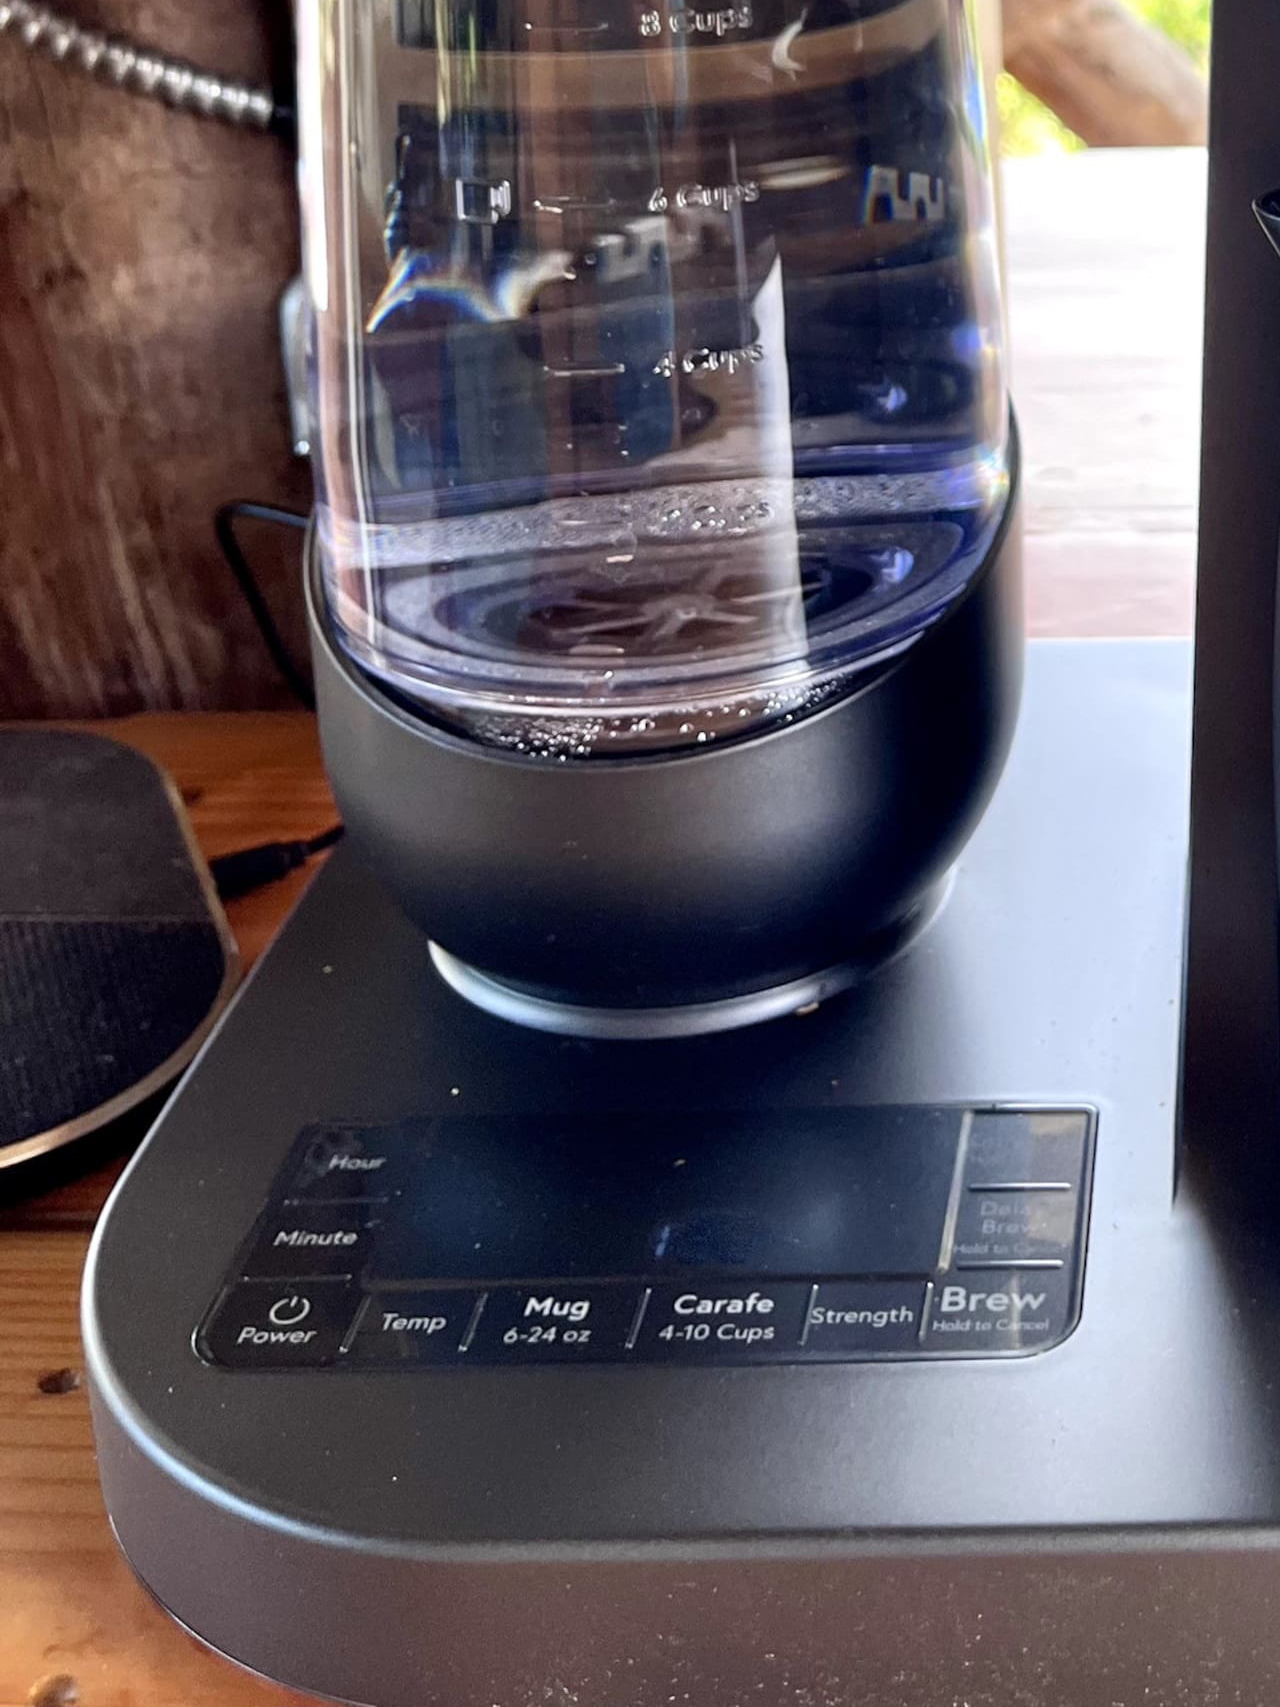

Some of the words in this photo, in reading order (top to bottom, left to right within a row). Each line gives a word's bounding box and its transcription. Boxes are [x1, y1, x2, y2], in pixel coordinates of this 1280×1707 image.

[640, 9, 662, 36] 8
[668, 5, 754, 36] Cups
[647, 186, 668, 212] 6
[676, 181, 760, 212] Cups
[328, 1154, 387, 1172] Hour
[272, 1229, 359, 1247] Minute
[523, 1296, 590, 1322] Mug
[673, 1292, 775, 1314] Carafe
[940, 1285, 1047, 1313] Brew
[381, 1312, 448, 1335] Temp
[810, 1305, 914, 1329] Strength
[932, 1318, 971, 1333] Hold
[975, 1318, 992, 1332] to
[995, 1318, 1050, 1332] Cancel
[236, 1326, 318, 1345] Power
[503, 1325, 557, 1344] 6-24
[562, 1329, 592, 1344] oz
[658, 1323, 710, 1341] 4-10
[717, 1323, 775, 1345] Cups
